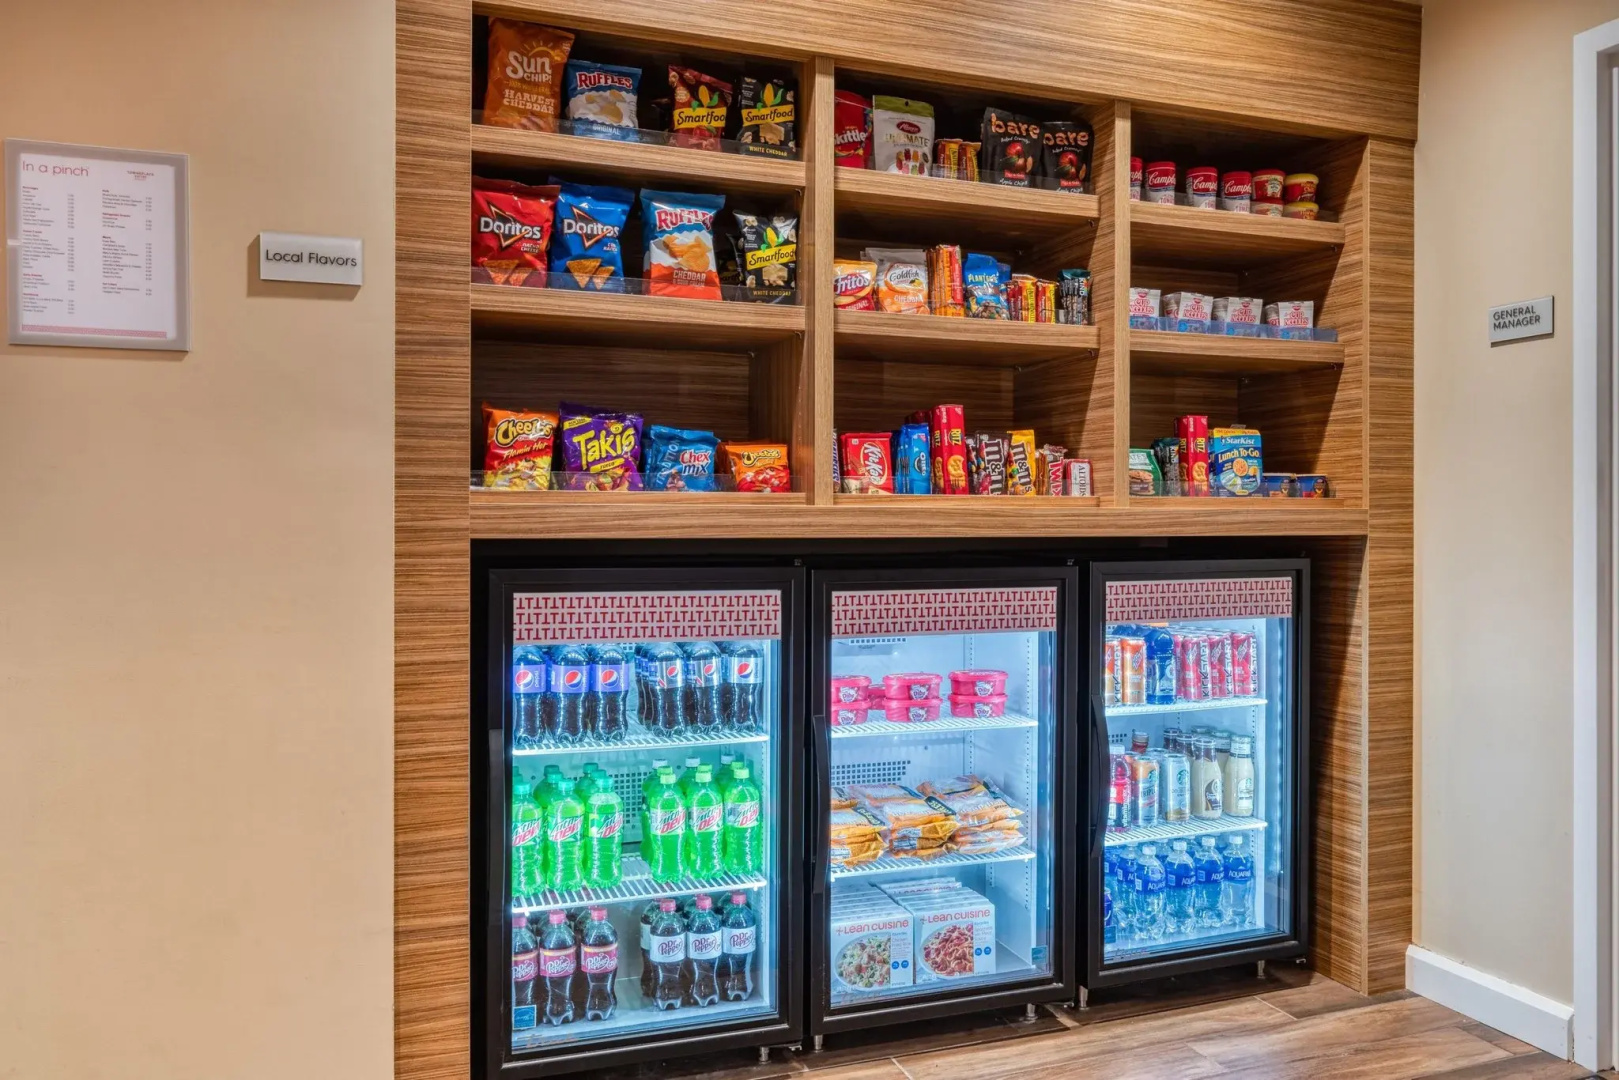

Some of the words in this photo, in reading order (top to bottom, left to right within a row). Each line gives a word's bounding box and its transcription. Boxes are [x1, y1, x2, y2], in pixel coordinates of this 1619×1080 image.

[506, 51, 552, 79] Sun
[576, 71, 632, 90] RUFFLES
[504, 89, 554, 106] HARVEST
[503, 98, 554, 114] CHEDDAR
[677, 111, 725, 125] Smartfoo
[745, 108, 794, 122] Smartfood
[592, 124, 620, 134] ORIGINAL
[991, 112, 1040, 139] bare
[766, 148, 788, 156] CHEDDAR
[23, 161, 34, 171] In
[38, 164, 48, 173] a
[53, 166, 89, 176] pinch
[480, 217, 542, 239] Doritos
[563, 218, 620, 238] Doritos
[266, 249, 303, 263] Local
[308, 252, 357, 266] Flavors
[749, 248, 795, 266] Smartfood
[673, 270, 706, 280] CHEDDAR
[890, 270, 919, 281] Goldfish
[1493, 305, 1536, 321] GENERAL
[1493, 315, 1540, 330] MANAGER
[952, 428, 962, 445] RITZ
[532, 441, 548, 453] Hot
[572, 422, 635, 470] Takis
[680, 450, 710, 464] Chex
[1219, 449, 1239, 463] Lunch
[1239, 448, 1259, 457] To-Go
[682, 463, 708, 476] mix
[928, 913, 952, 923] Lean
[954, 909, 990, 920] cuisine
[844, 924, 870, 934] Lean
[871, 920, 908, 931] cuisine
[661, 943, 681, 955] Pepper
[693, 940, 715, 952] Pepper
